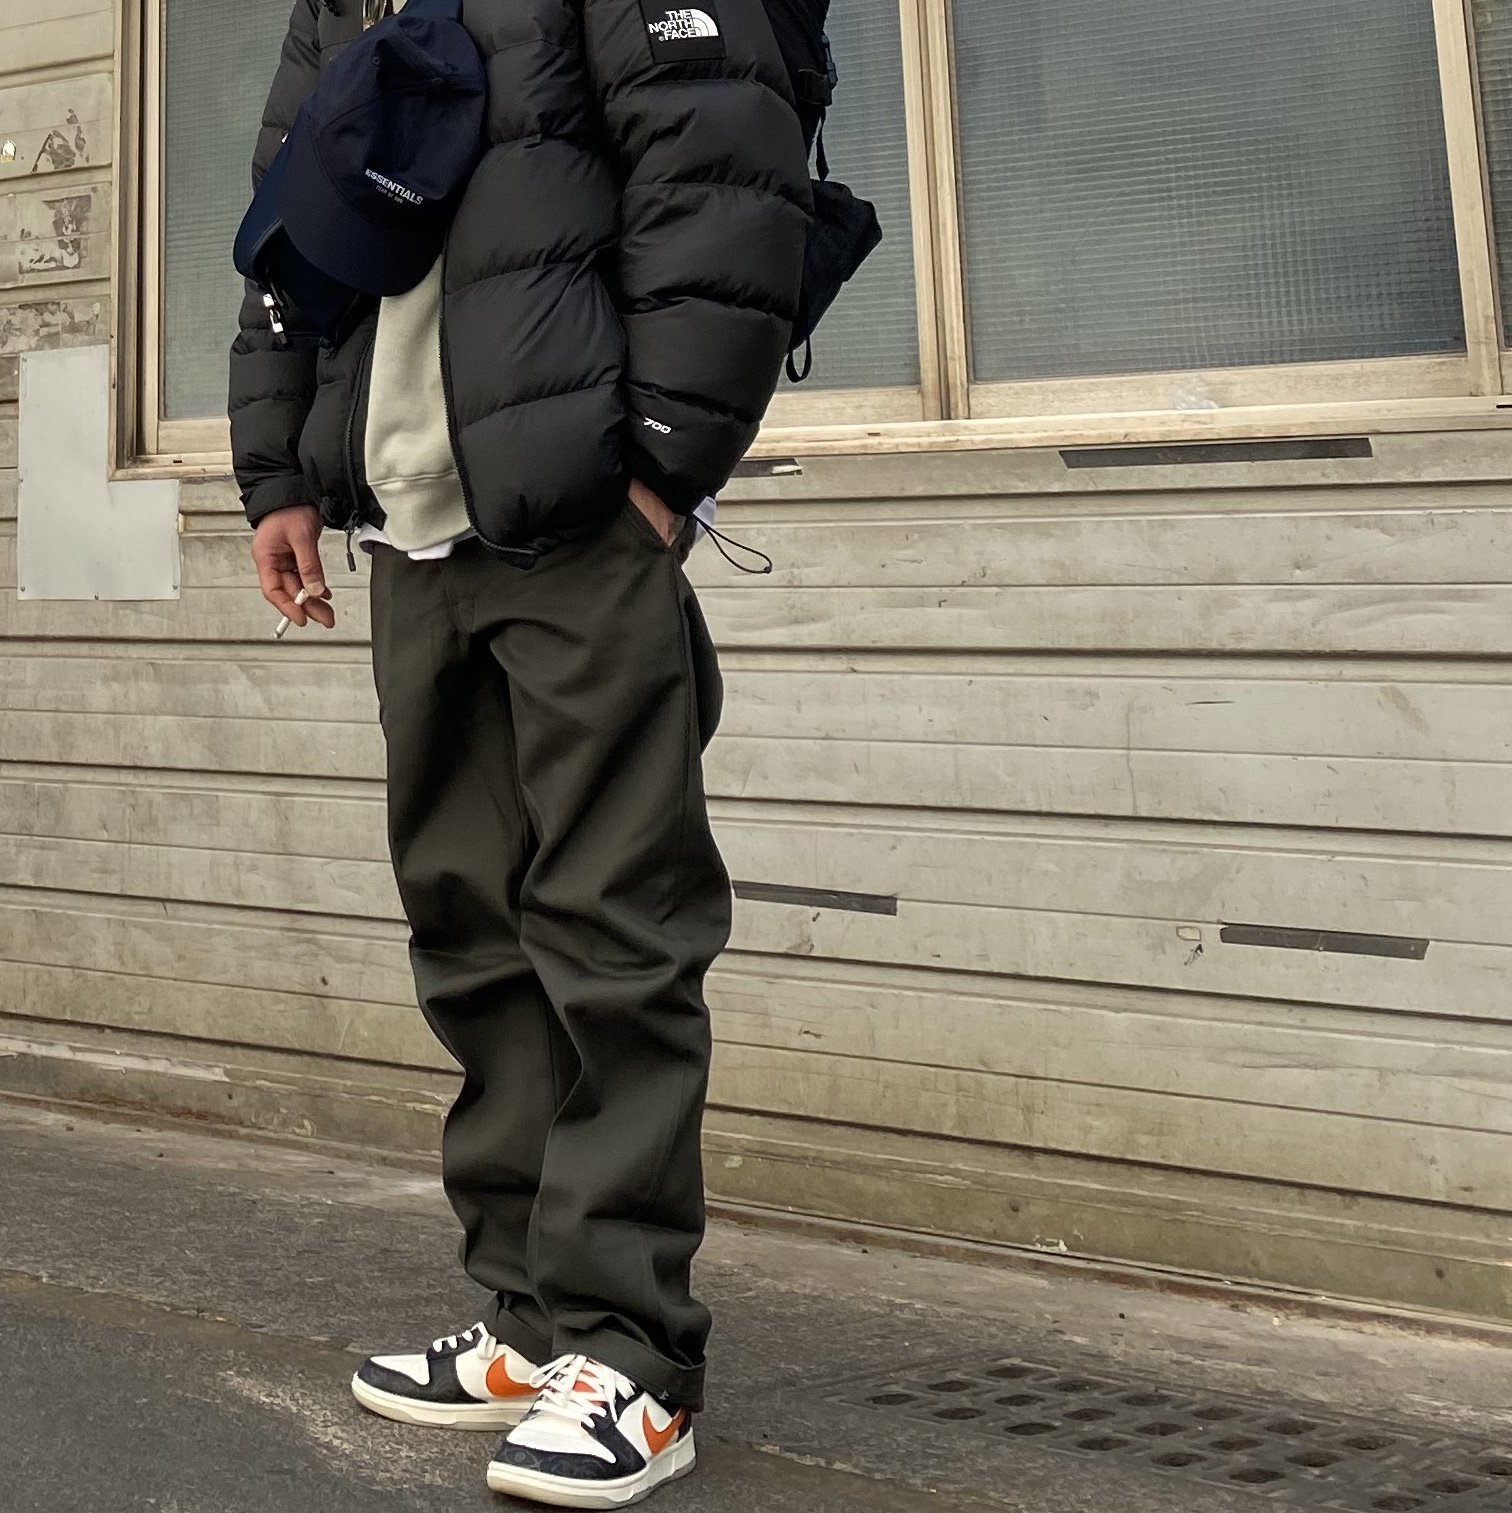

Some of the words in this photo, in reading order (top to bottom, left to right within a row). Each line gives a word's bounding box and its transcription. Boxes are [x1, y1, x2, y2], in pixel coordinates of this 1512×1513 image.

[665, 9, 691, 21] THE
[648, 19, 694, 34] NORTH
[664, 28, 696, 41] FACE
[365, 168, 424, 206] ESSENTIALS
[643, 416, 672, 434] 700
